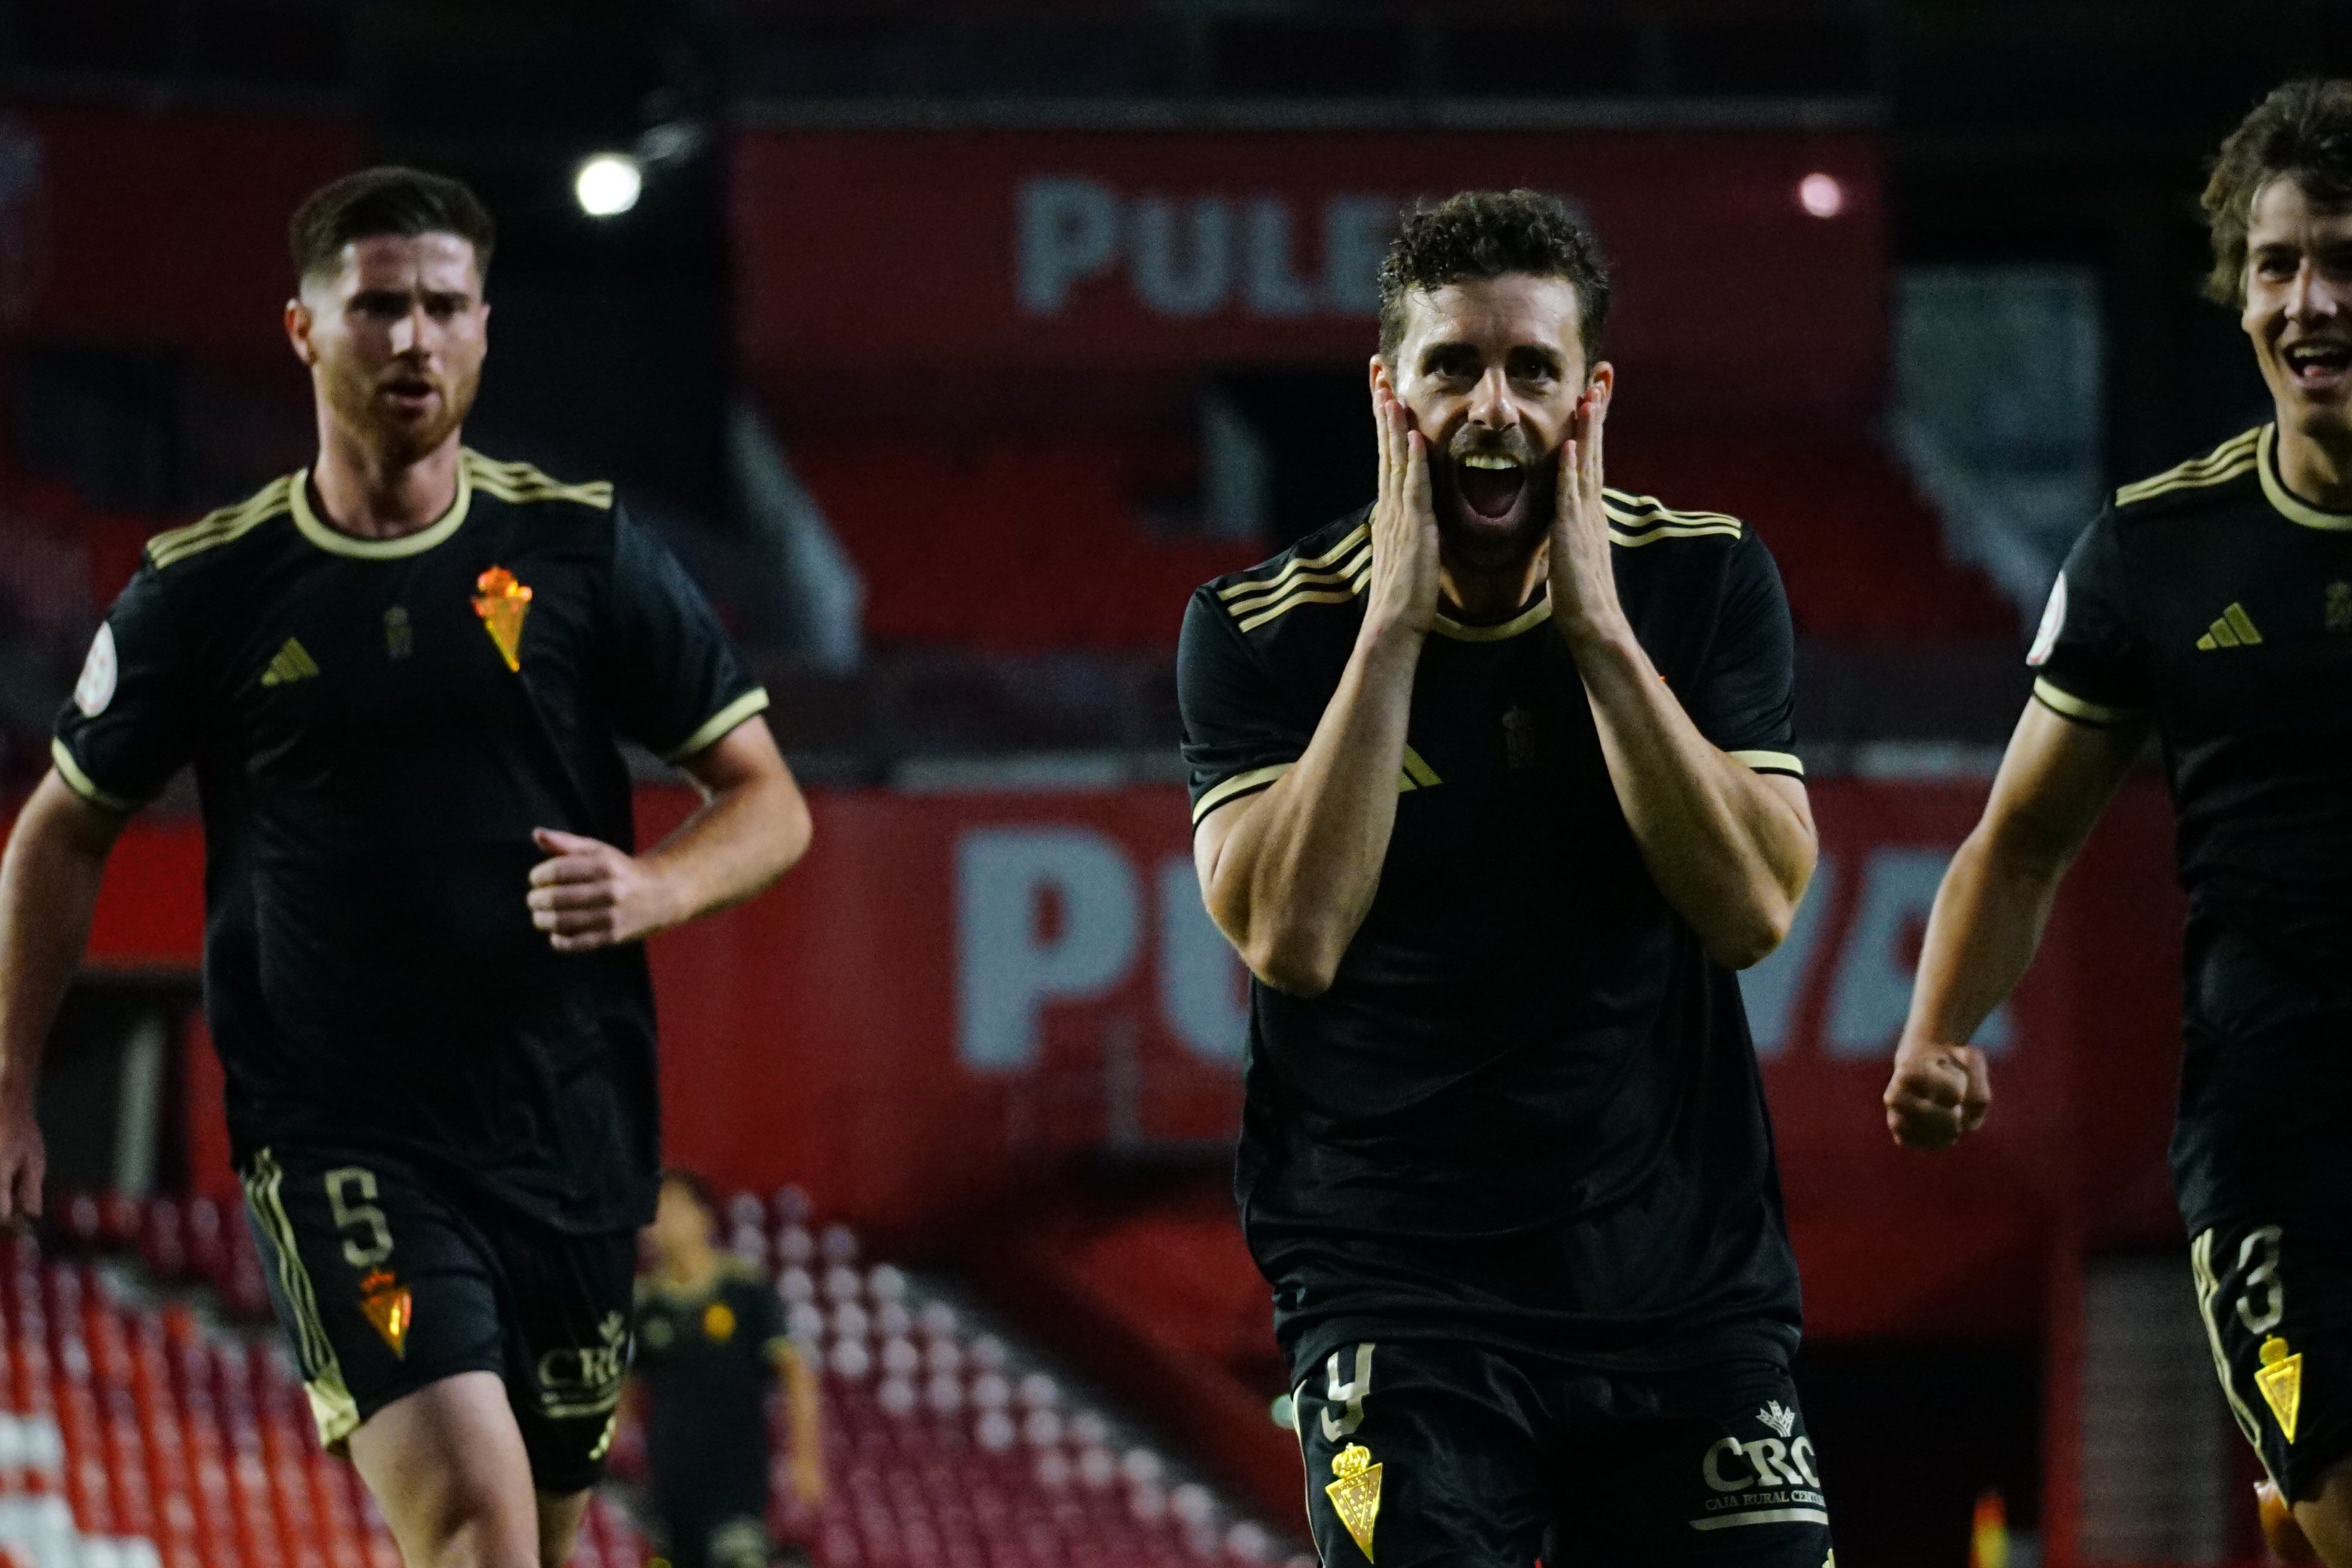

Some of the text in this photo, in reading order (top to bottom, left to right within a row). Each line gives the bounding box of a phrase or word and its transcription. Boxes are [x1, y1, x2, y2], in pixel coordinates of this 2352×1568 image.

[324, 1166, 395, 1268] 5
[2236, 1224, 2284, 1335] 3
[1703, 1437, 1821, 1492] CRC
[1742, 1491, 1789, 1506] RURAL
